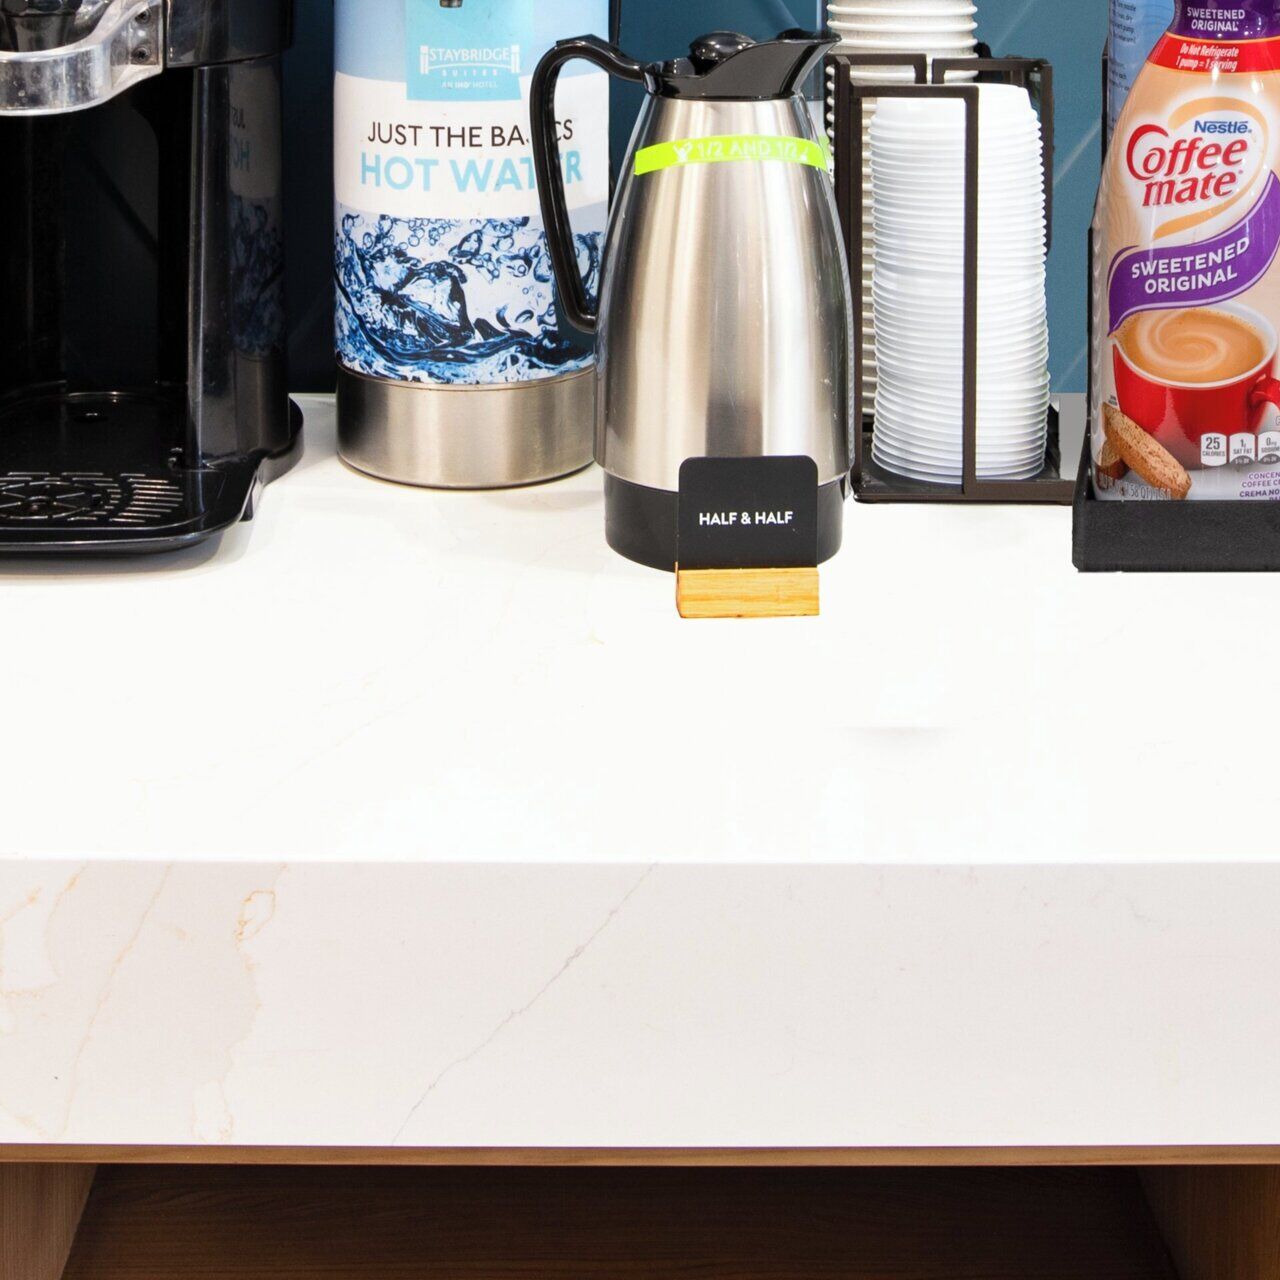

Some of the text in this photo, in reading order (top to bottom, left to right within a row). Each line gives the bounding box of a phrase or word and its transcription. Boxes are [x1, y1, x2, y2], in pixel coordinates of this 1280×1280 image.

[1186, 6, 1246, 20] SWEETENED
[1190, 19, 1238, 32] ORIGINAL
[428, 47, 510, 61] STAYBRIDGE
[1180, 42, 1240, 59] Do Not Refrigerate
[1179, 57, 1199, 70] pump
[1209, 59, 1238, 72] serving
[441, 68, 499, 77] SUITES
[472, 81, 499, 89] HOTEL
[367, 118, 573, 148] JUST THE BACS
[1194, 120, 1249, 134] Nestlé
[697, 142, 724, 158] 1/2
[729, 140, 772, 157] AND
[1125, 123, 1248, 181] Coffee
[361, 149, 583, 193] HOT WATR
[1142, 170, 1237, 207] mate
[1131, 236, 1250, 279] SWEETENED
[1144, 265, 1238, 295] ORIGINAL
[1205, 436, 1220, 450] 25
[1241, 480, 1272, 488] COFFEE
[1240, 489, 1267, 498] CREMA
[699, 510, 794, 526] HALF & HALF
